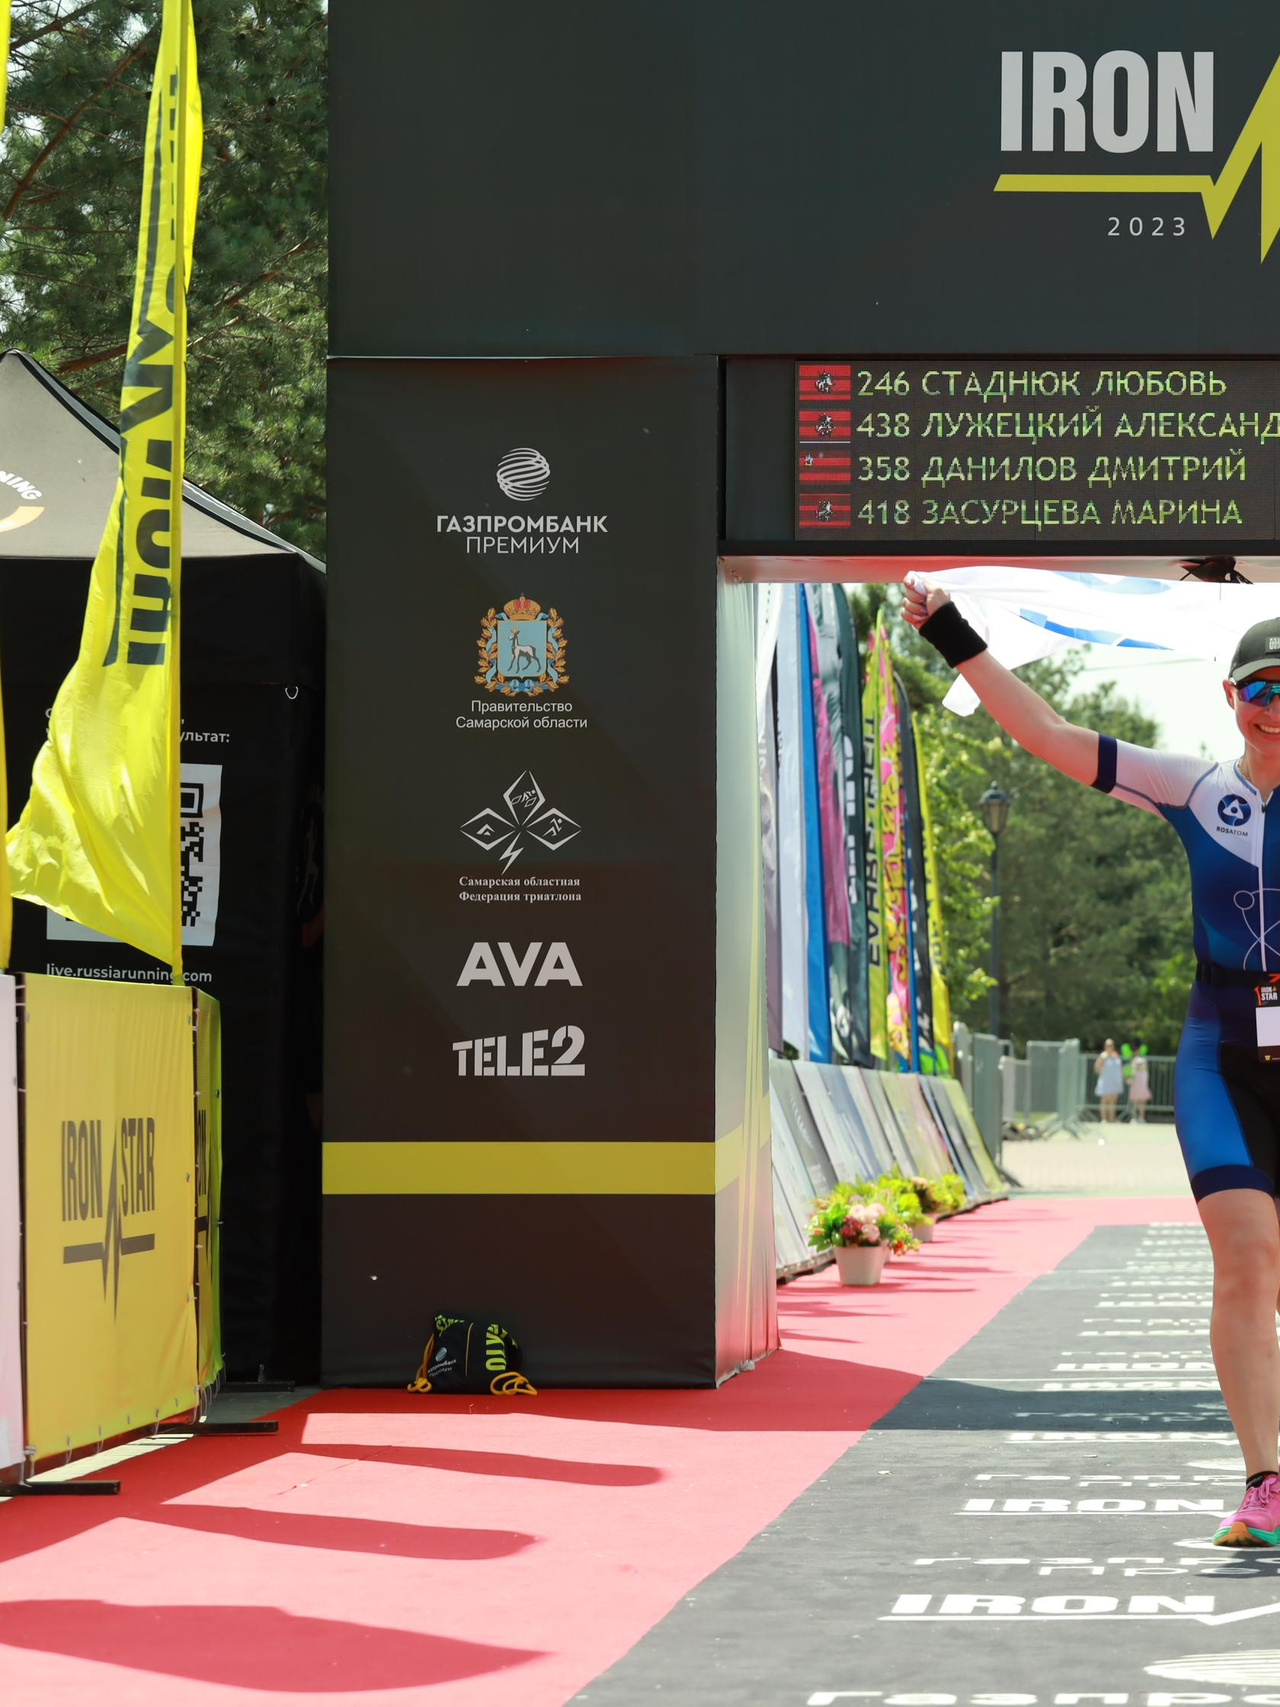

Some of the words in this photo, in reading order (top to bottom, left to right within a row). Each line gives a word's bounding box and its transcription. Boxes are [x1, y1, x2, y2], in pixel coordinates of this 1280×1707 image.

[1001, 50, 1214, 153] IRON
[1107, 216, 1186, 236] 2023
[857, 371, 910, 395] 246
[921, 371, 1080, 402] СТАДНЮК
[1091, 371, 1228, 396] ЛЮБОВЬ
[857, 413, 910, 437] 438
[921, 405, 1102, 445] ЛУЖЕЦКИЙ
[857, 456, 910, 481] 358
[921, 456, 1077, 488] ДАНИЛОВ
[1088, 449, 1246, 488] ДМИТРИЙ
[436, 515, 608, 533] ГАЗПРОМБАНК
[857, 500, 910, 524] 418
[921, 500, 1100, 531] ЗАСУРЦЕВА
[1111, 500, 1242, 524] МАРИНА
[466, 536, 580, 554] ПРЕМИУМ
[471, 700, 573, 714] Правительство
[455, 715, 530, 731] Самарской
[533, 716, 588, 728] области
[180, 730, 231, 744] ультат:
[1216, 825, 1249, 837] ROSATOM
[458, 876, 521, 888] Самарская
[523, 876, 580, 887] областная
[458, 890, 521, 903] Федерация
[523, 891, 582, 903] триатлона
[46, 963, 212, 983] live.russiarunnincom
[456, 941, 583, 987] AVA
[1261, 992, 1278, 1001] STAR
[452, 1025, 586, 1077] TELE2
[61, 1119, 104, 1222] IRON
[121, 1116, 156, 1217] STAR
[1008, 1431, 1237, 1441] IRON
[964, 1498, 1225, 1512] IRON
[890, 1593, 1216, 1614] IRON
